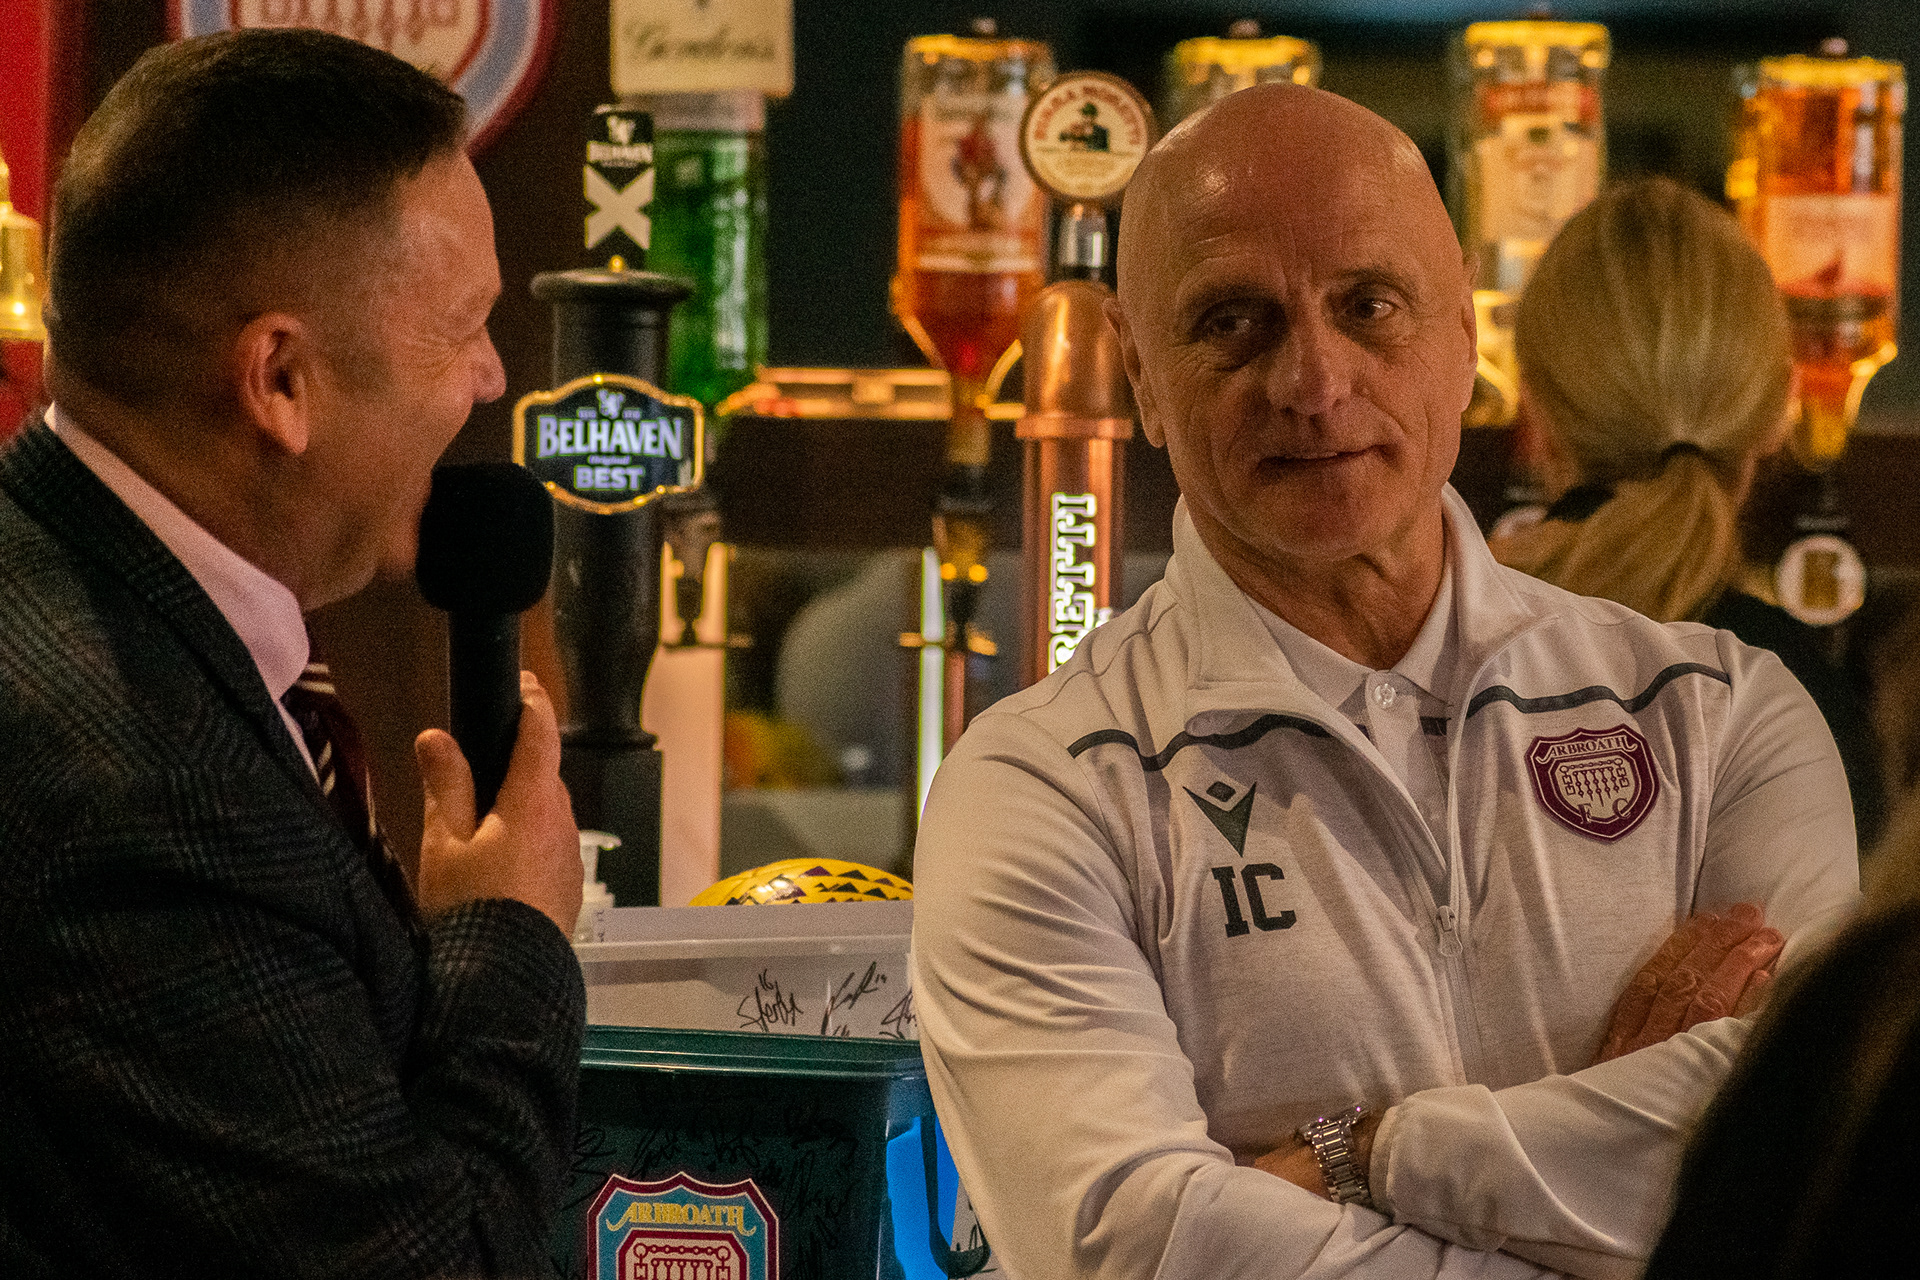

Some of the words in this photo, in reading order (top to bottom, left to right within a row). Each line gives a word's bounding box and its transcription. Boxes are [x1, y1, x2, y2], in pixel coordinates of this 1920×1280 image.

[537, 414, 683, 460] BELHAVEN
[574, 465, 644, 490] BEST
[1535, 733, 1638, 764] ARBROATH
[1211, 862, 1298, 938] IC
[605, 1200, 757, 1237] ARBROATH
